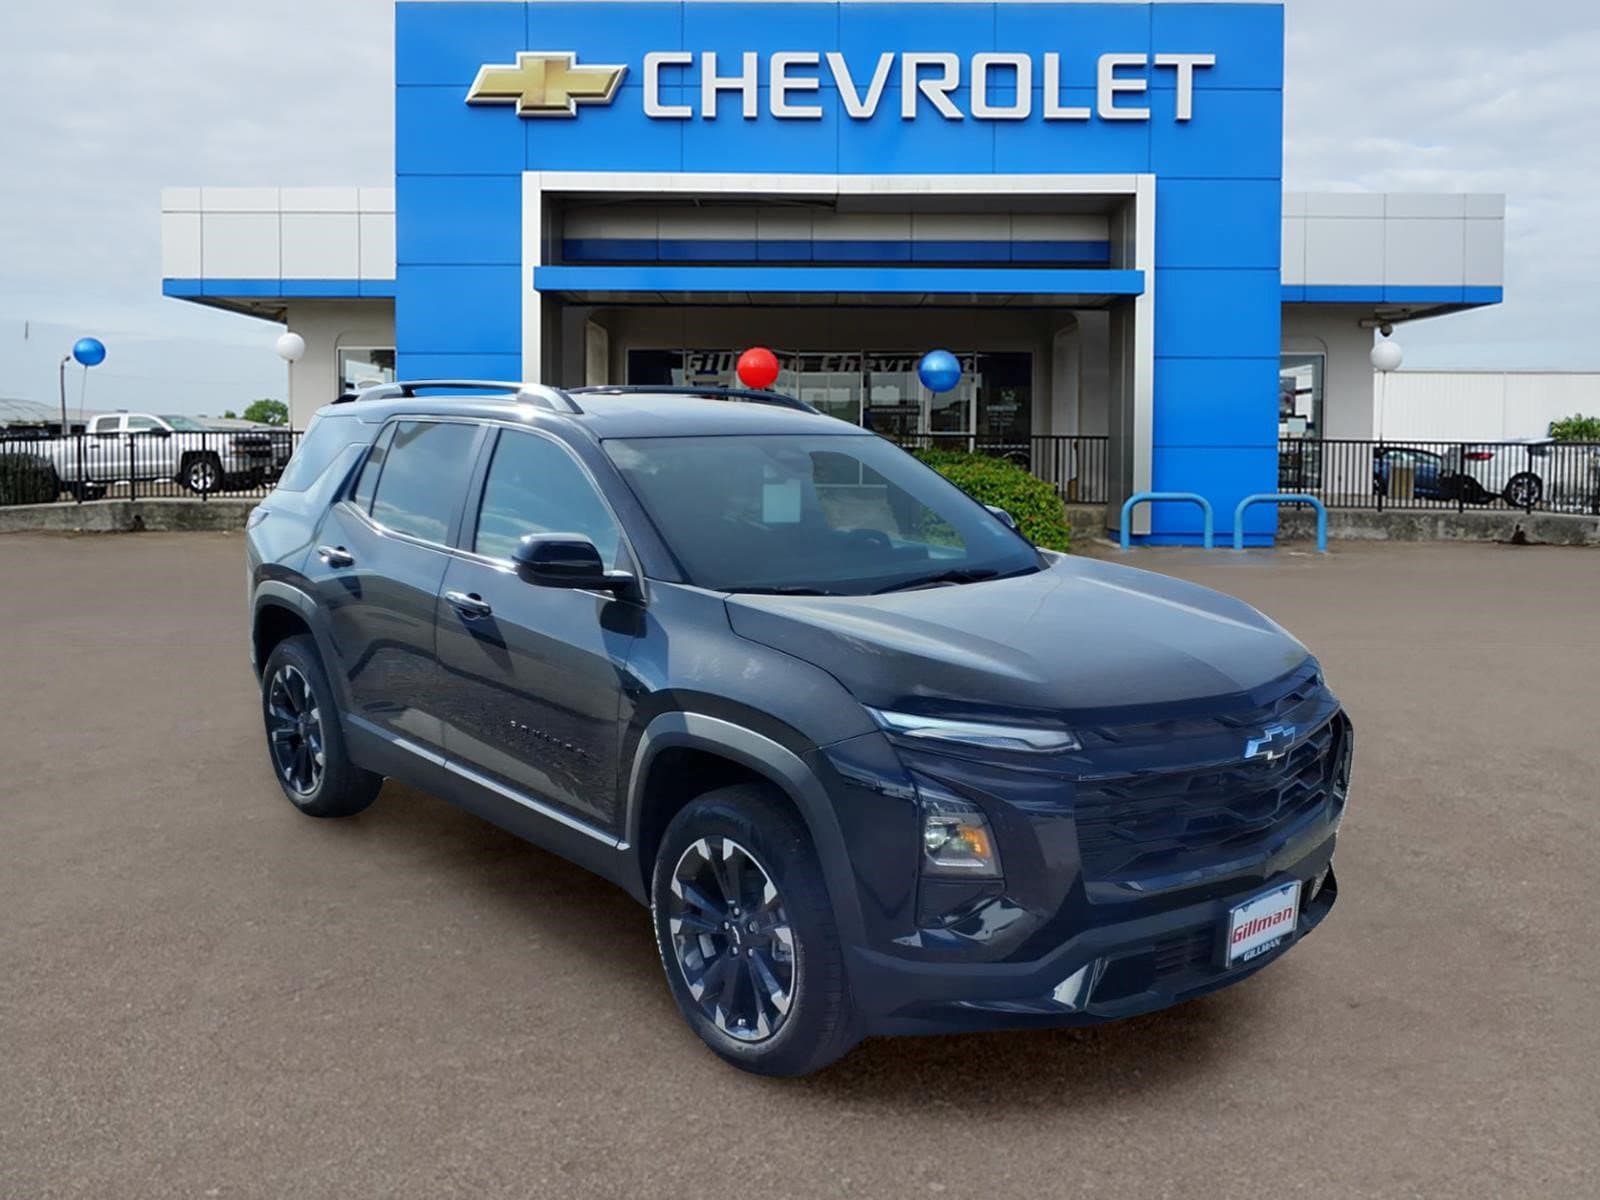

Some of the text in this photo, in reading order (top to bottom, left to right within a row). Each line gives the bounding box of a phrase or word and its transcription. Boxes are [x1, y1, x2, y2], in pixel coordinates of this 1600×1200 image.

[642, 51, 1217, 121] CHEVROLET
[687, 353, 804, 374] Gilln
[1232, 907, 1293, 944] Gillman
